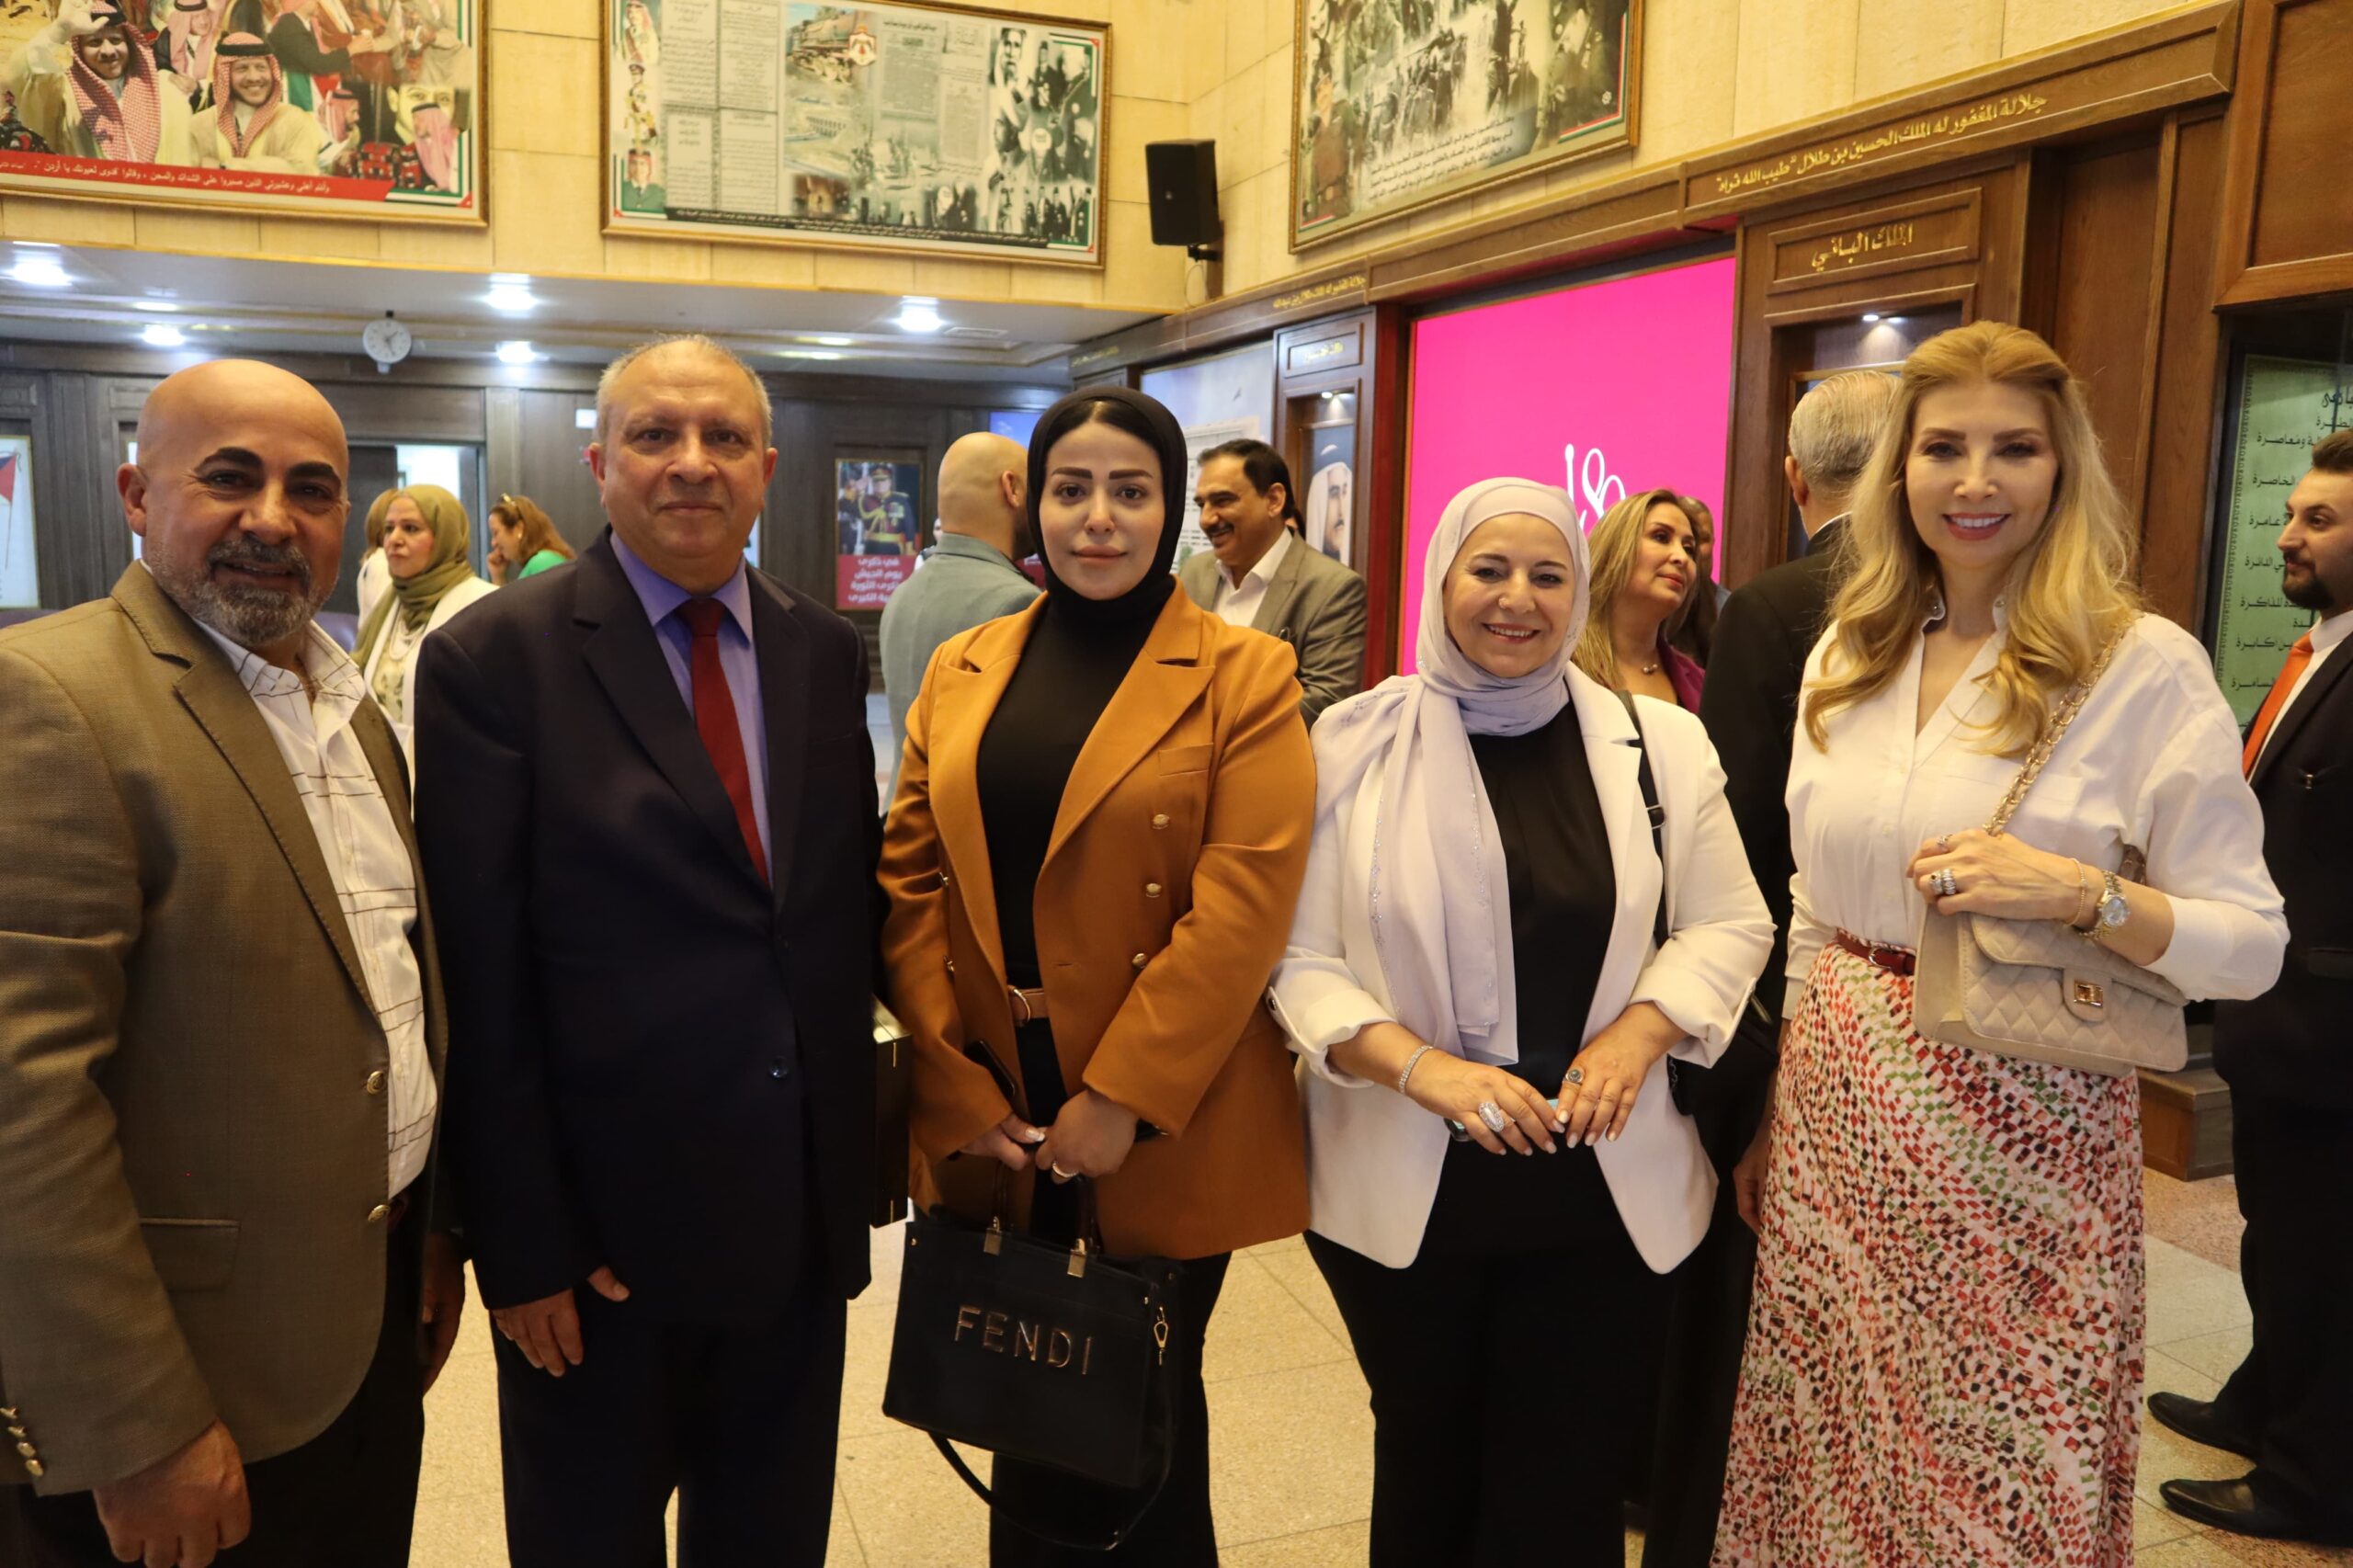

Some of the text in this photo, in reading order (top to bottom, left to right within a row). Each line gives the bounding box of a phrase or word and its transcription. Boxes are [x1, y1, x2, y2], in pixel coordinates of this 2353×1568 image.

[2000, 94, 2047, 115] جلالة
[1933, 116, 1949, 133] له
[1949, 103, 1997, 135] المغفور
[1899, 121, 1930, 142] الملك
[1831, 147, 1848, 165] بن
[1848, 129, 1898, 160] الحسين
[1797, 150, 1830, 175] طلال
[1743, 167, 1761, 184] الله
[1871, 222, 1914, 250] الملك
[954, 1304, 1092, 1376] FENDI
